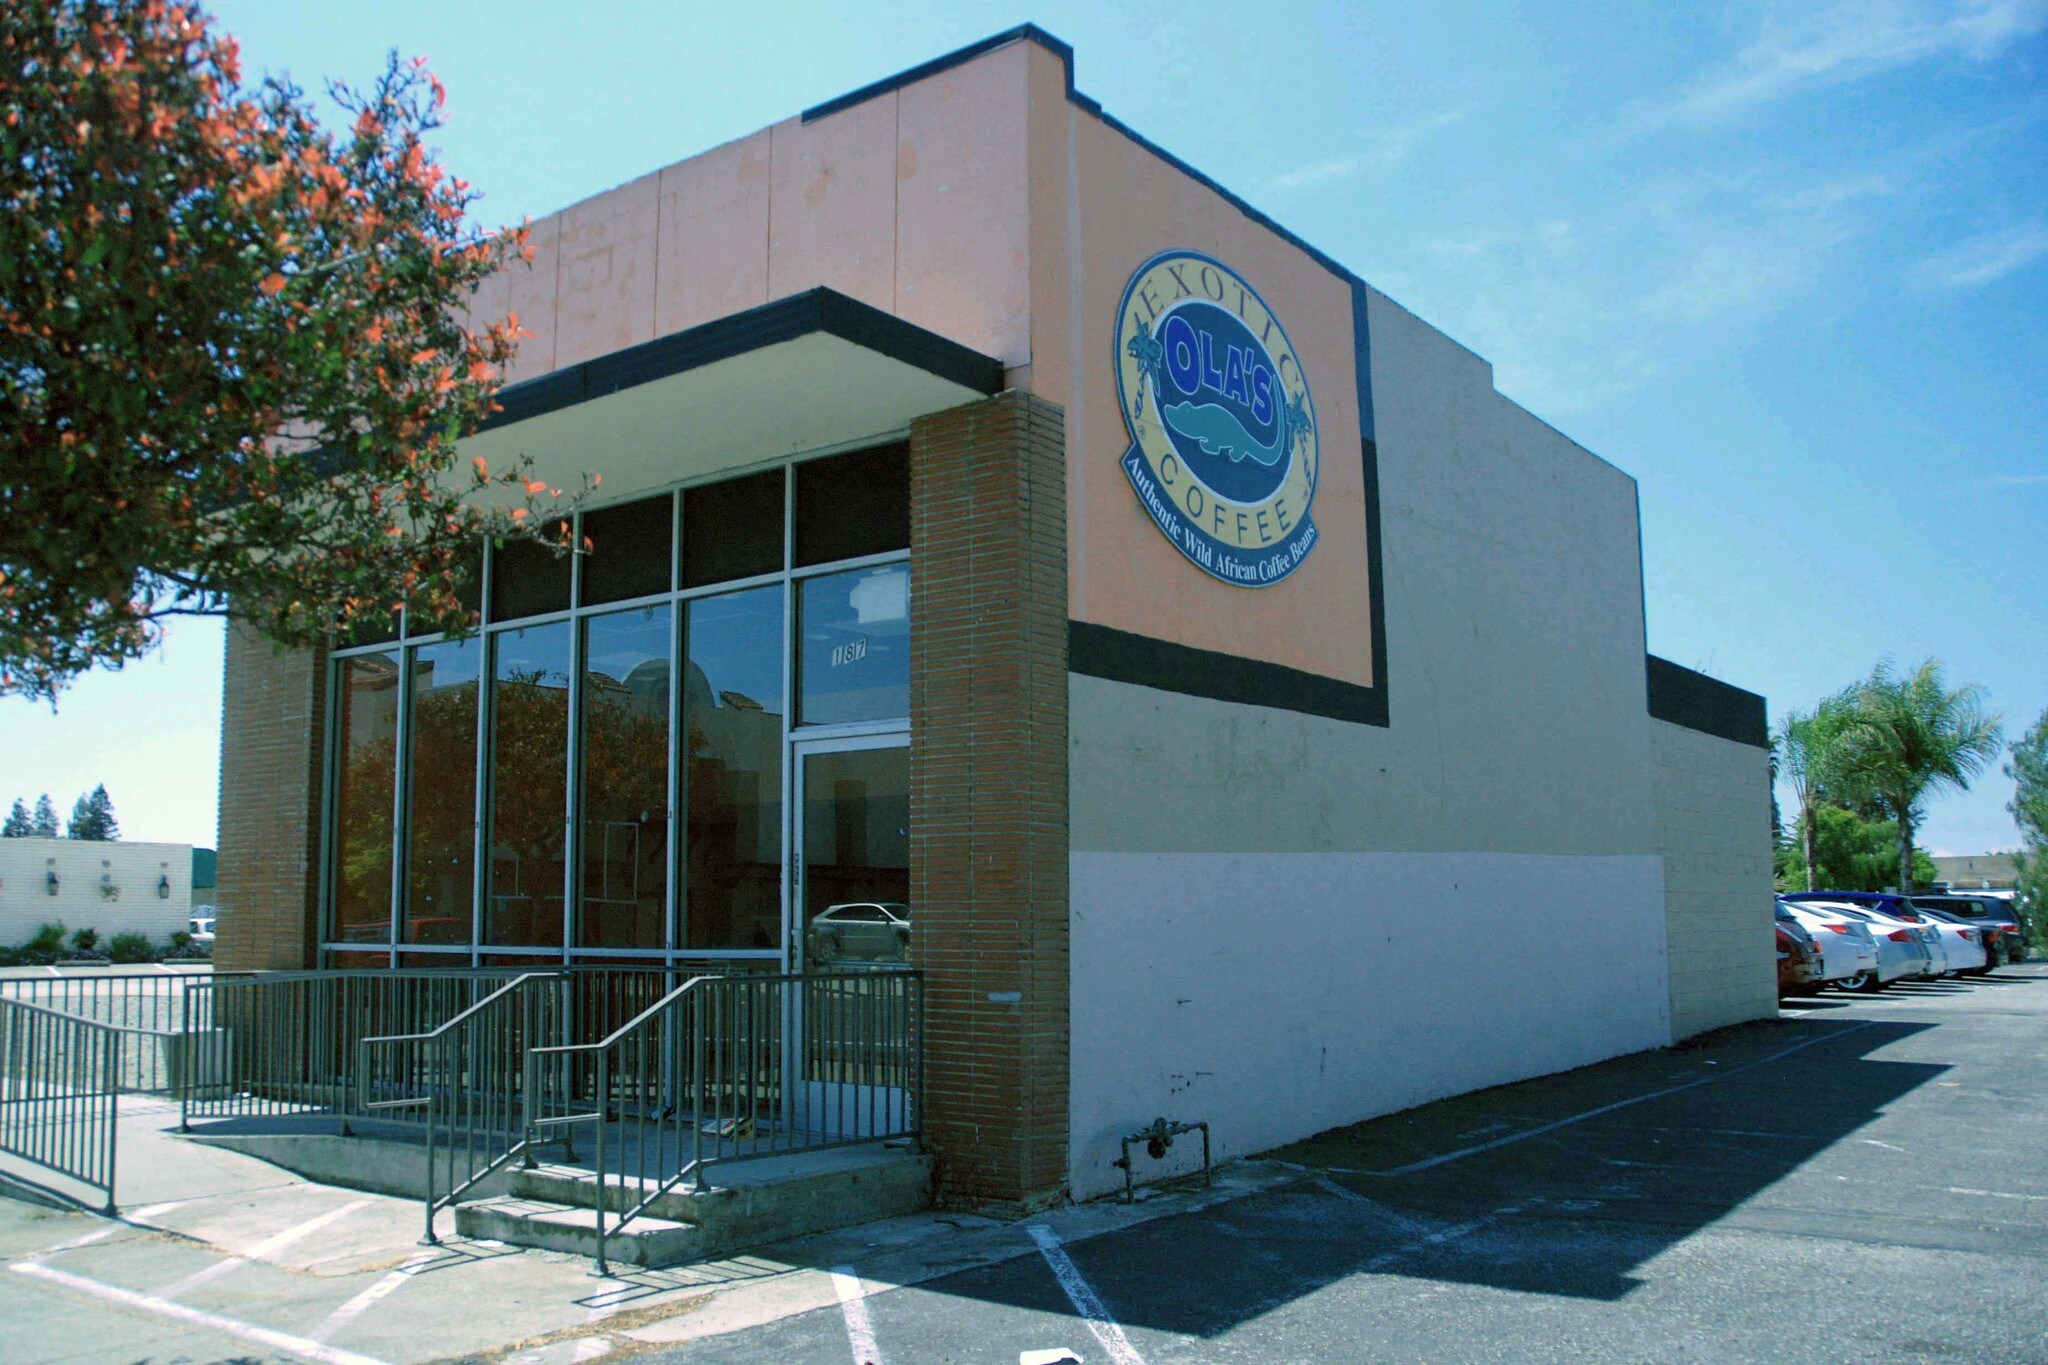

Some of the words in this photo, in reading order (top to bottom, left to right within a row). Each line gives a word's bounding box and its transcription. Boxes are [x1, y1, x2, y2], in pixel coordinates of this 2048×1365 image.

[1138, 263, 1302, 389] EXOTIC
[1164, 315, 1274, 426] OLA'S
[1128, 457, 1181, 540] Authentic
[1184, 527, 1212, 568] Wild
[1215, 553, 1257, 581] African
[1259, 553, 1291, 581] Coffee
[1289, 523, 1316, 563] Beans
[1160, 453, 1291, 543] COFFEE
[834, 639, 866, 665] 187
